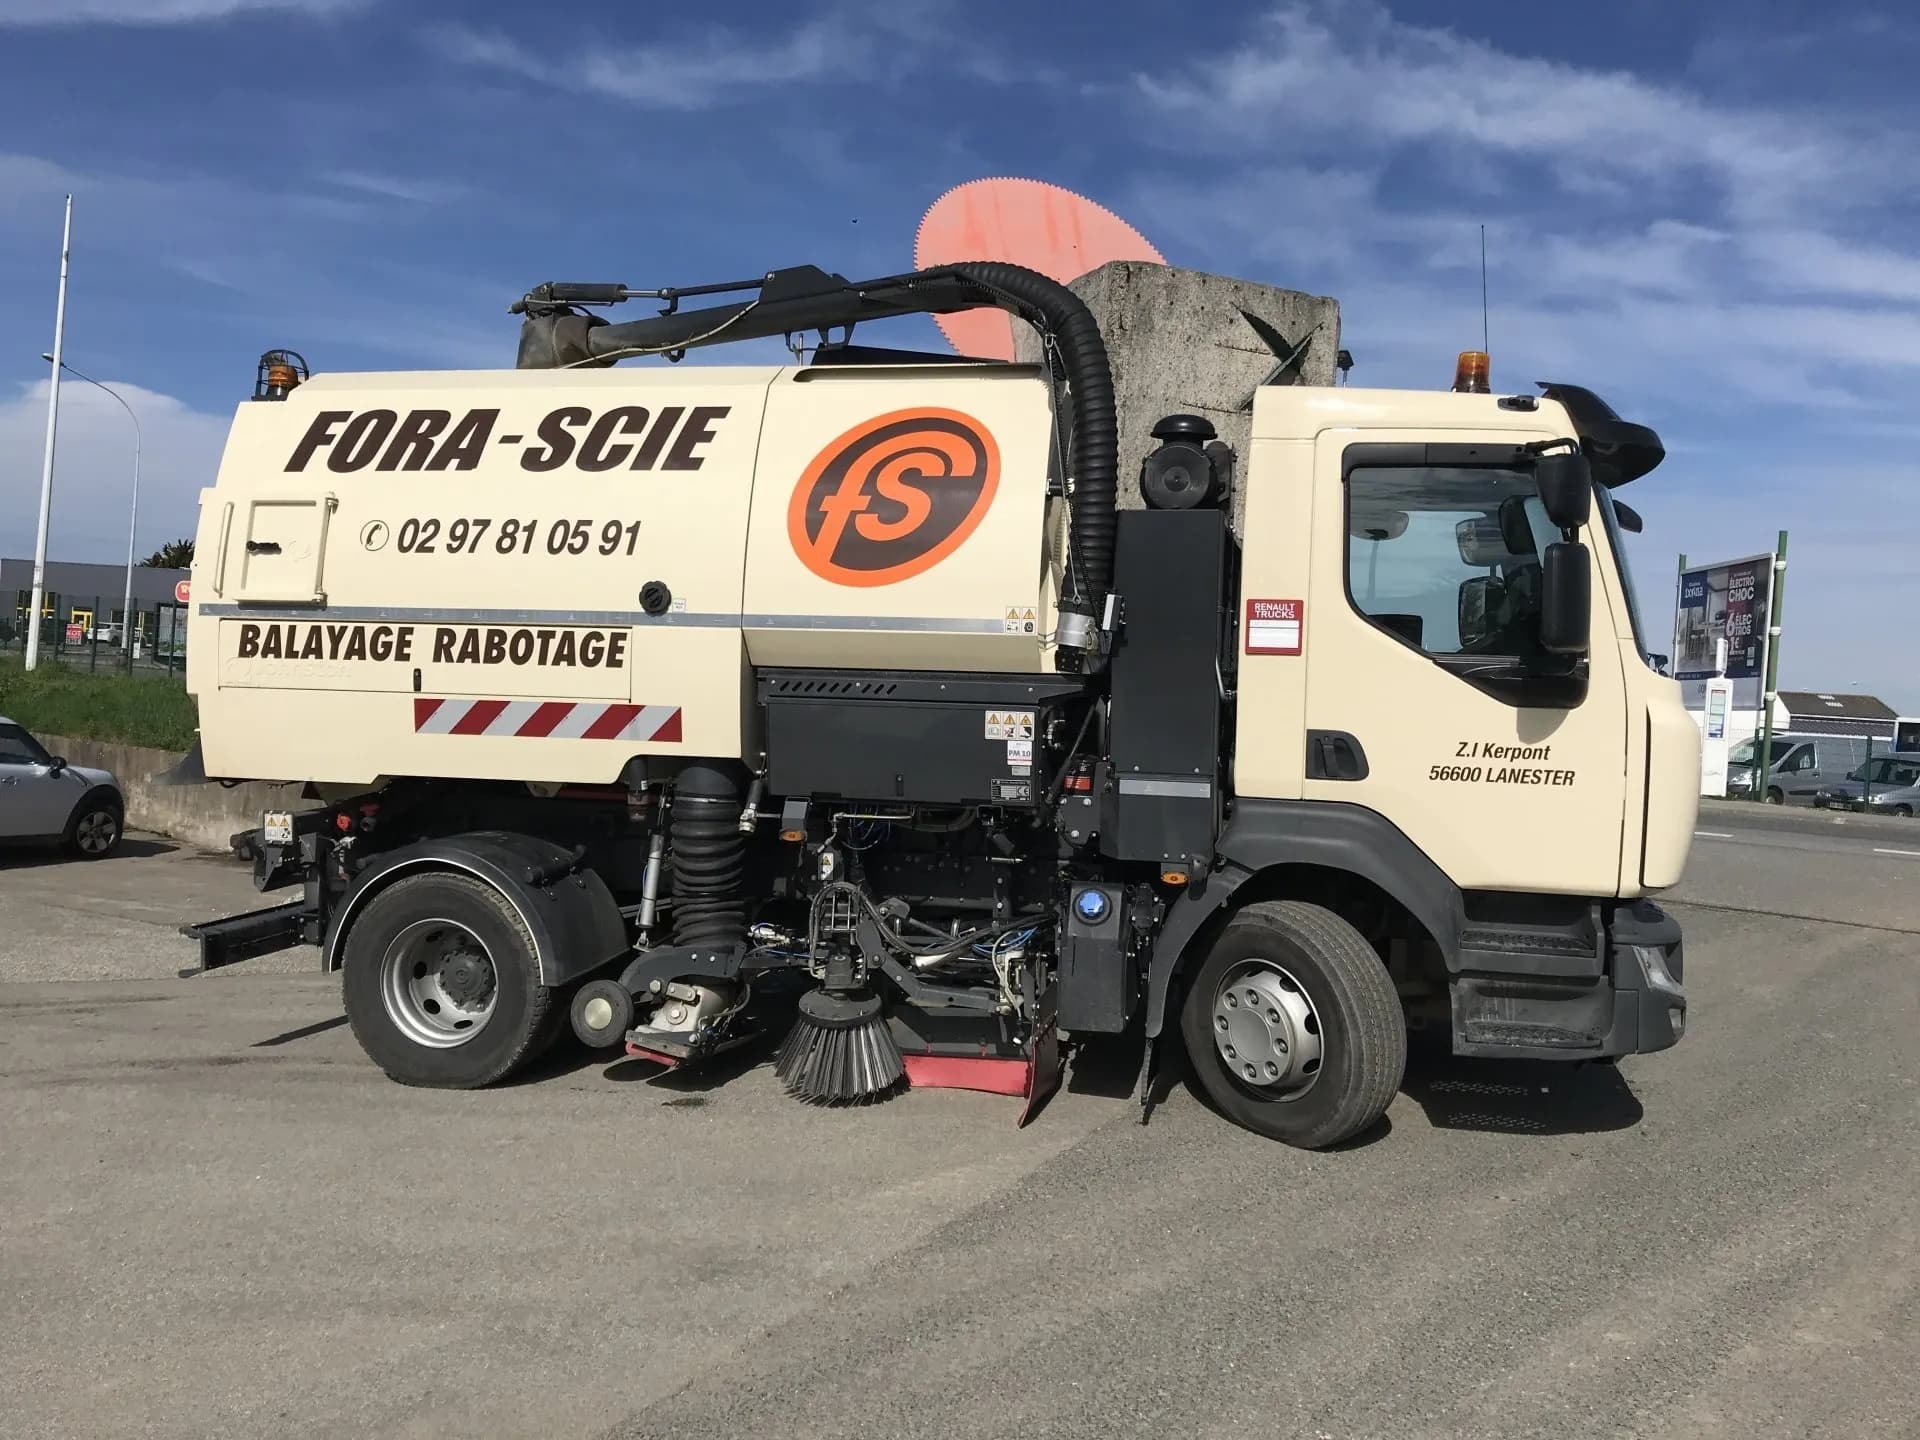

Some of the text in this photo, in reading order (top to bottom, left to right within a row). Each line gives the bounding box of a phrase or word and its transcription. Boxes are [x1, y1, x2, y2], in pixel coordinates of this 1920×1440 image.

[284, 406, 731, 473] FORA-SCIE
[397, 518, 642, 556] 02 97 81 05 91
[1729, 587, 1754, 602] CHOC
[1254, 602, 1296, 611] RENAULT
[1256, 610, 1296, 619] TRUCKS
[238, 624, 626, 669] BALAYAGE RABOTAGE
[1456, 742, 1551, 763] Z.I Kerpont
[1429, 765, 1575, 787] 56600 LANESTER
